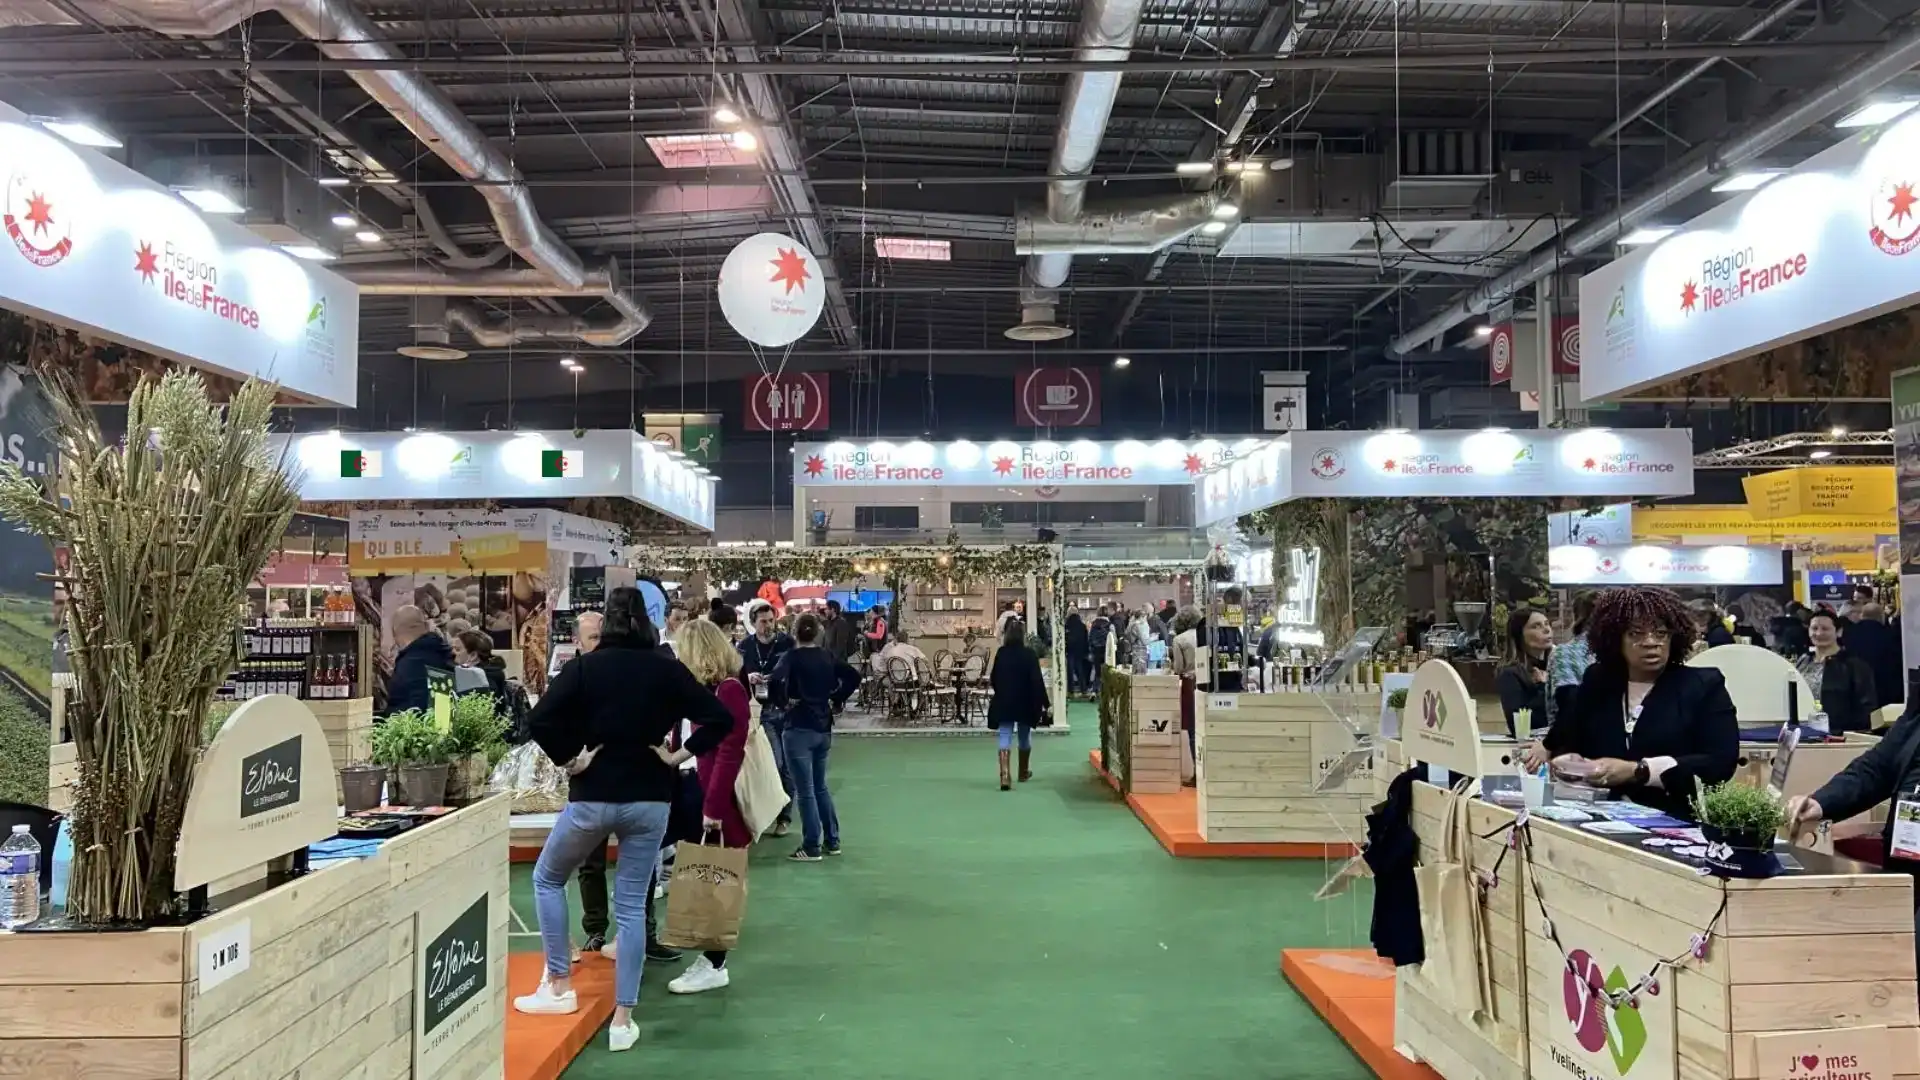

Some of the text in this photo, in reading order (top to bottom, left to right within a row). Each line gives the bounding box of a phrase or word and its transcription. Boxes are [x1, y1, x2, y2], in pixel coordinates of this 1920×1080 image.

[1702, 245, 1754, 284] Région
[212, 952, 218, 971] 3
[220, 948, 225, 967] M
[1825, 1055, 1858, 1070] mes
